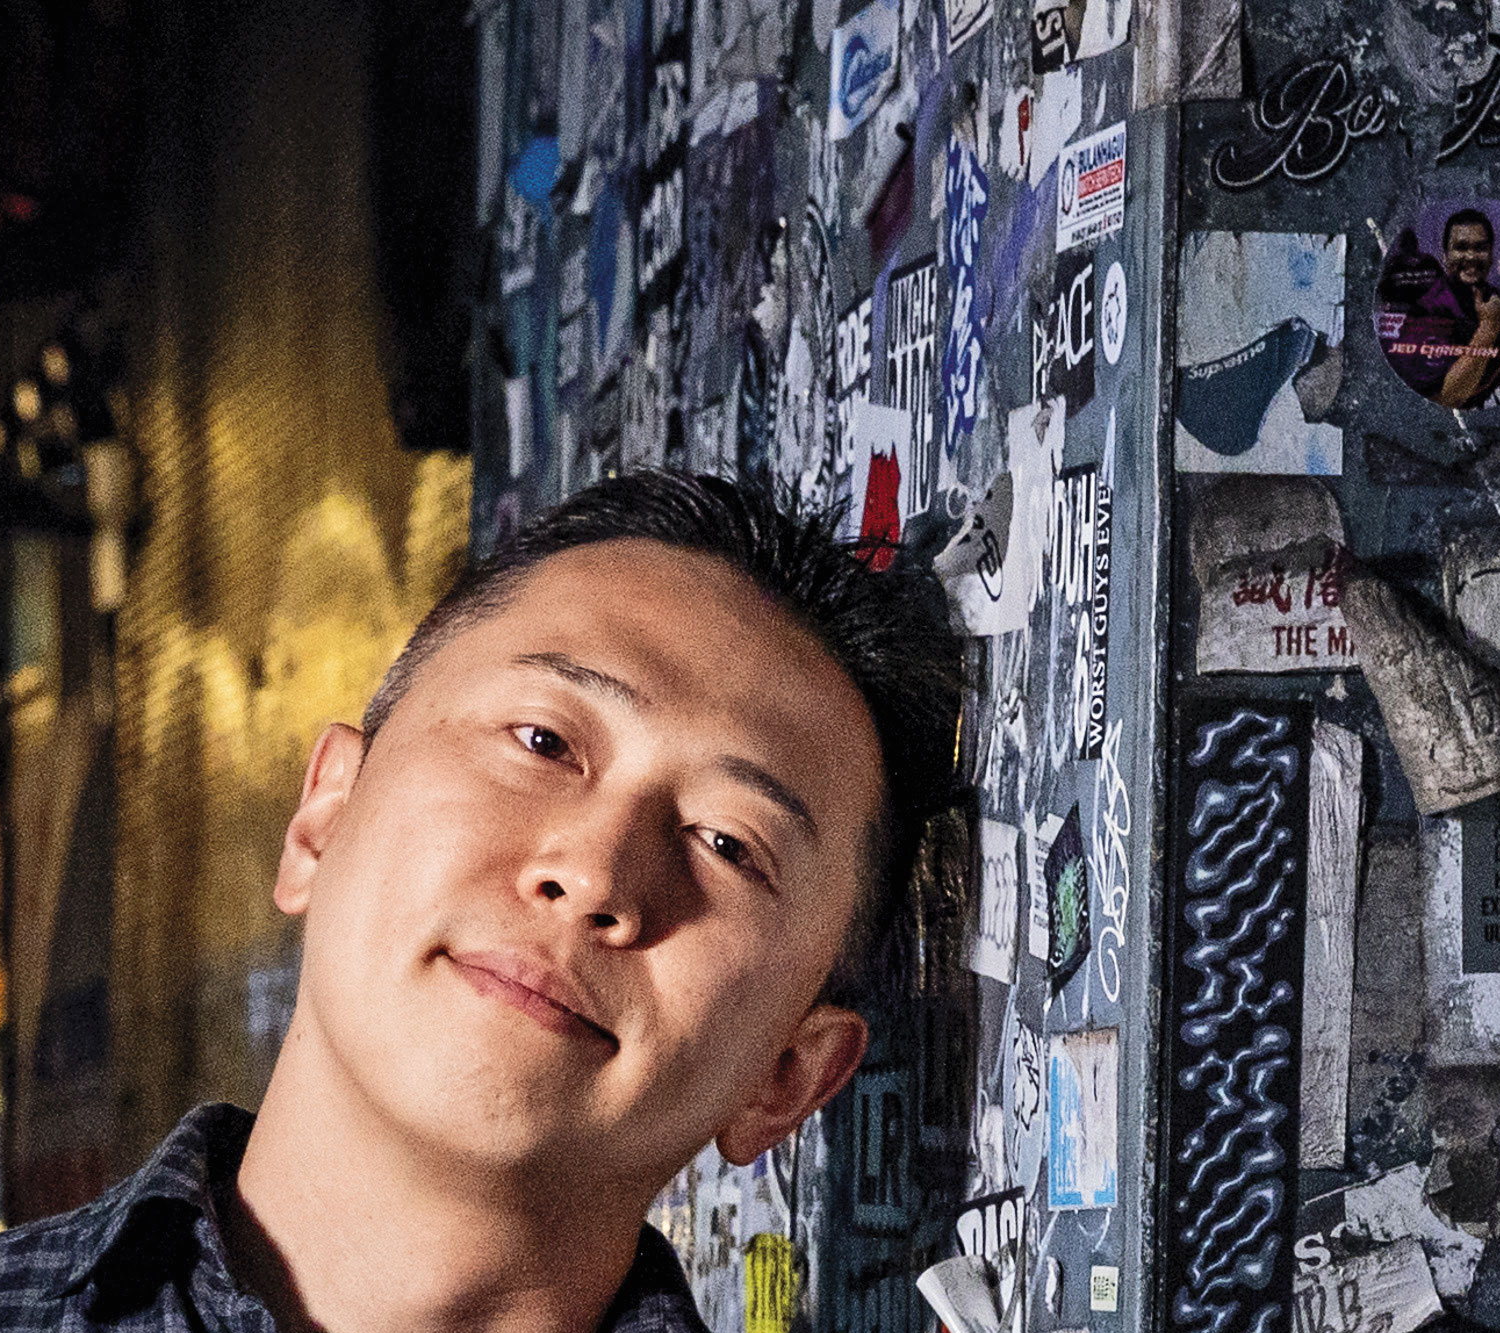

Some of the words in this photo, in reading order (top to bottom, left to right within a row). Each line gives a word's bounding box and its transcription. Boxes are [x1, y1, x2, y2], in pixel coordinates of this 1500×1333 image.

[1094, 554, 1109, 636] GUYS
[1272, 625, 1318, 658] THE
[1088, 646, 1107, 748] WORST
